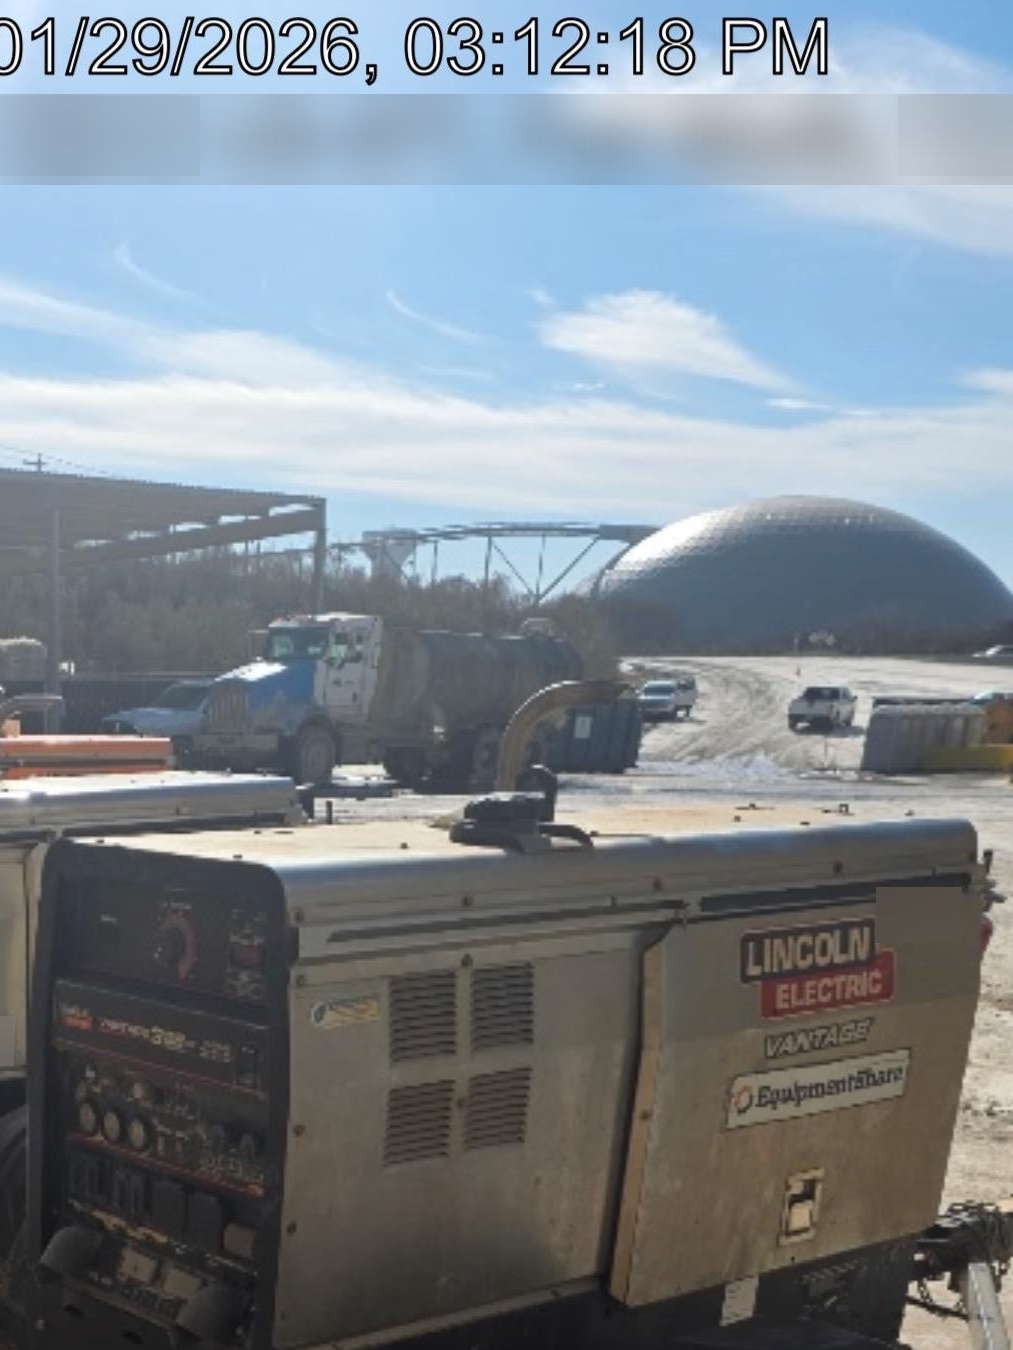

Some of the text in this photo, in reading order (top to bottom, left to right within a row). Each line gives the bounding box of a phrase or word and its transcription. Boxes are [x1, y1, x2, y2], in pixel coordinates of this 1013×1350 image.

[746, 927, 870, 977] LINCOLN
[776, 968, 883, 1009] ELECTRIC
[765, 1018, 872, 1059] VANTAGE
[755, 1067, 904, 1110] EquipmentShare
